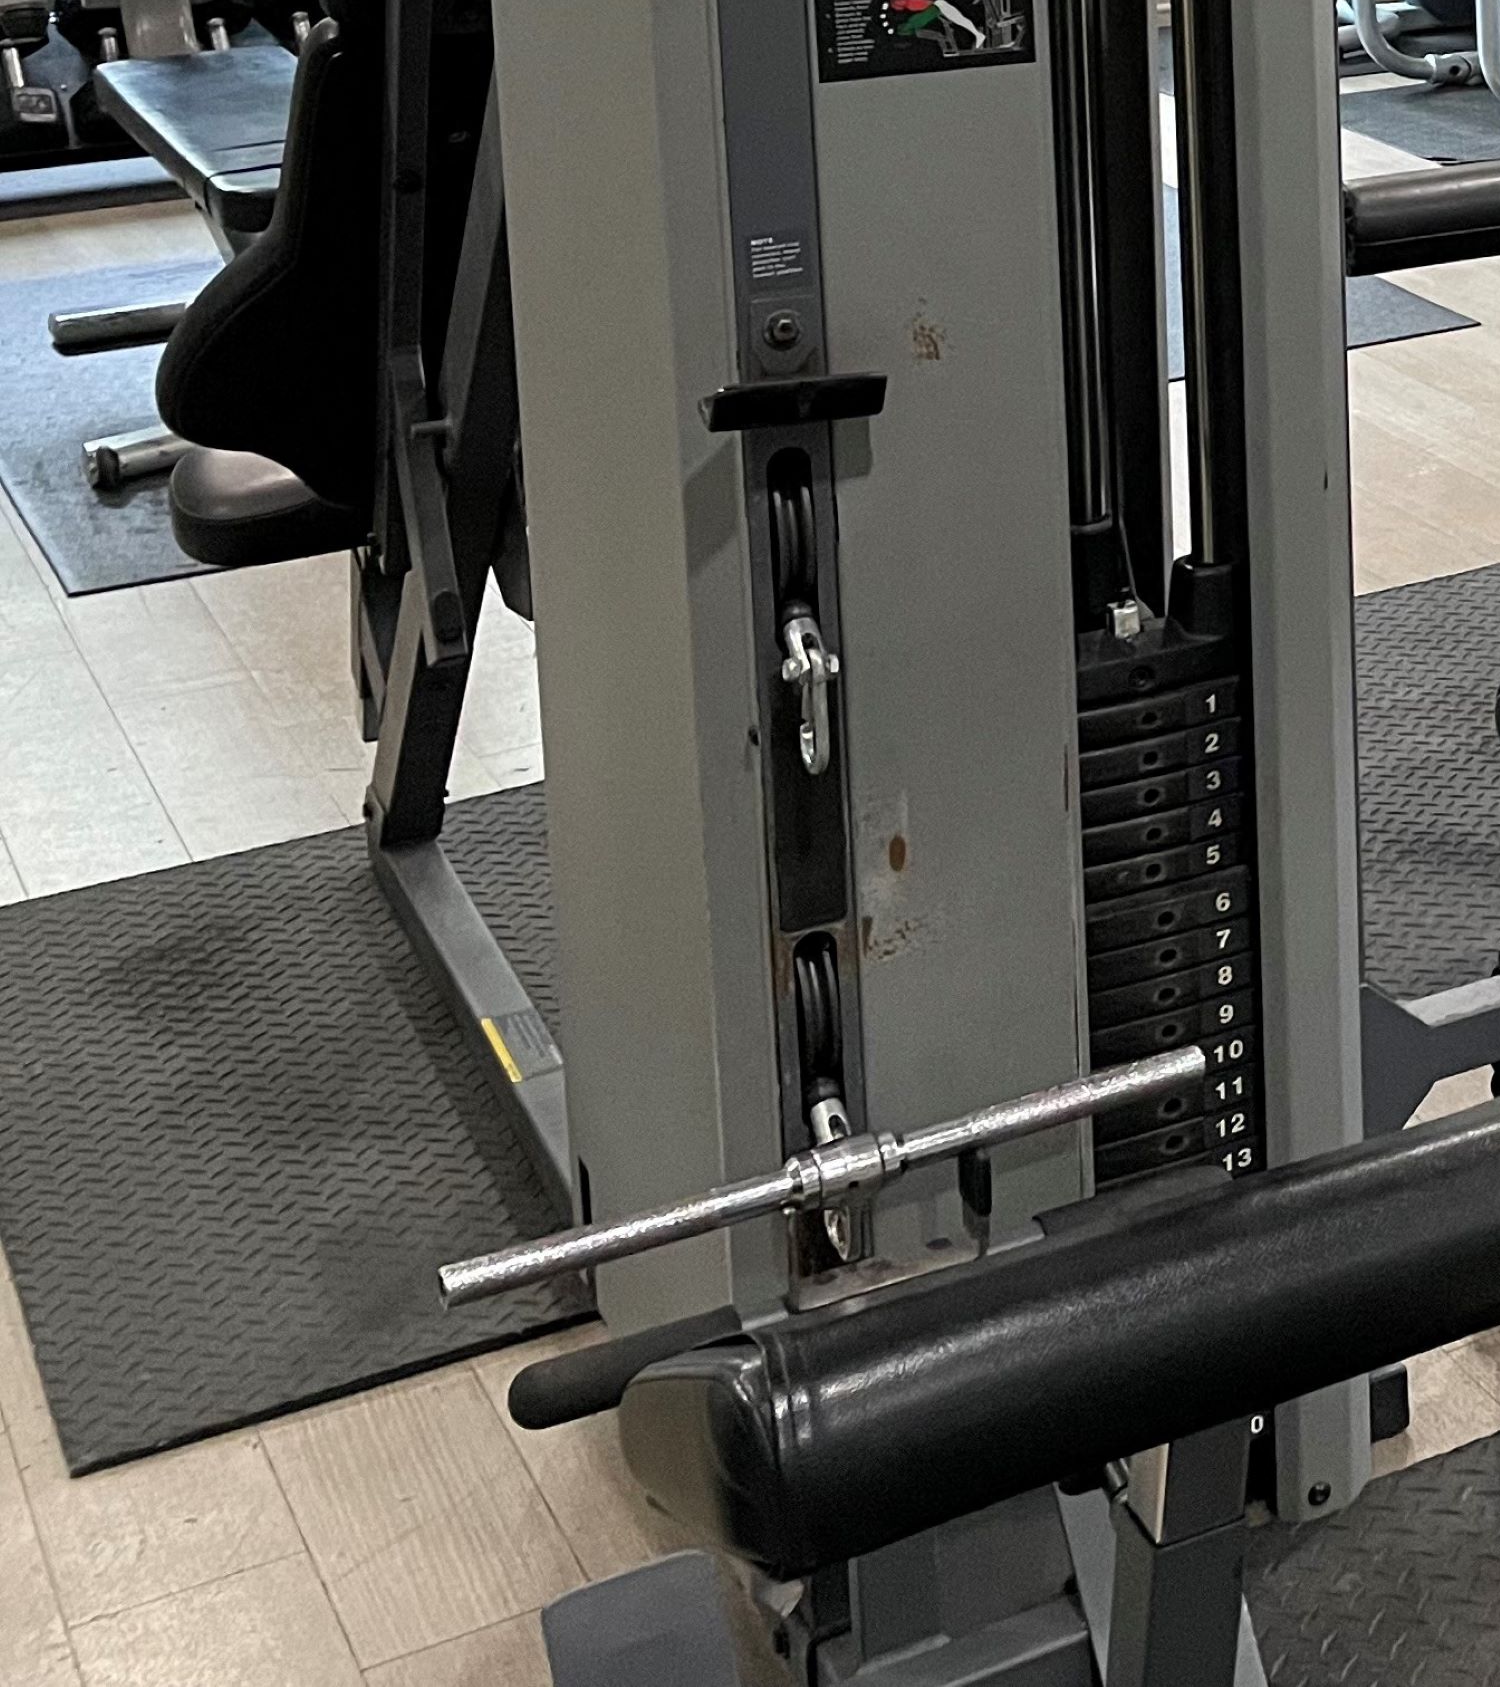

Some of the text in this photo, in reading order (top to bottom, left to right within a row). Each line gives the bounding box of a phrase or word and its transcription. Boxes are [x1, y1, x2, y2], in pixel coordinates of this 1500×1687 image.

[1205, 693, 1216, 713] 1
[1205, 733, 1221, 753] 2
[1206, 770, 1221, 790] 3
[1207, 808, 1222, 828] 4
[1206, 844, 1221, 864] 5
[1215, 892, 1231, 912] 6
[1216, 928, 1232, 949] 7
[1218, 965, 1233, 985] 8
[1219, 1004, 1234, 1024] 9
[1213, 1039, 1244, 1063] 10
[1215, 1076, 1243, 1100] 11
[1215, 1113, 1245, 1137] 12
[1222, 1148, 1252, 1171] 13
